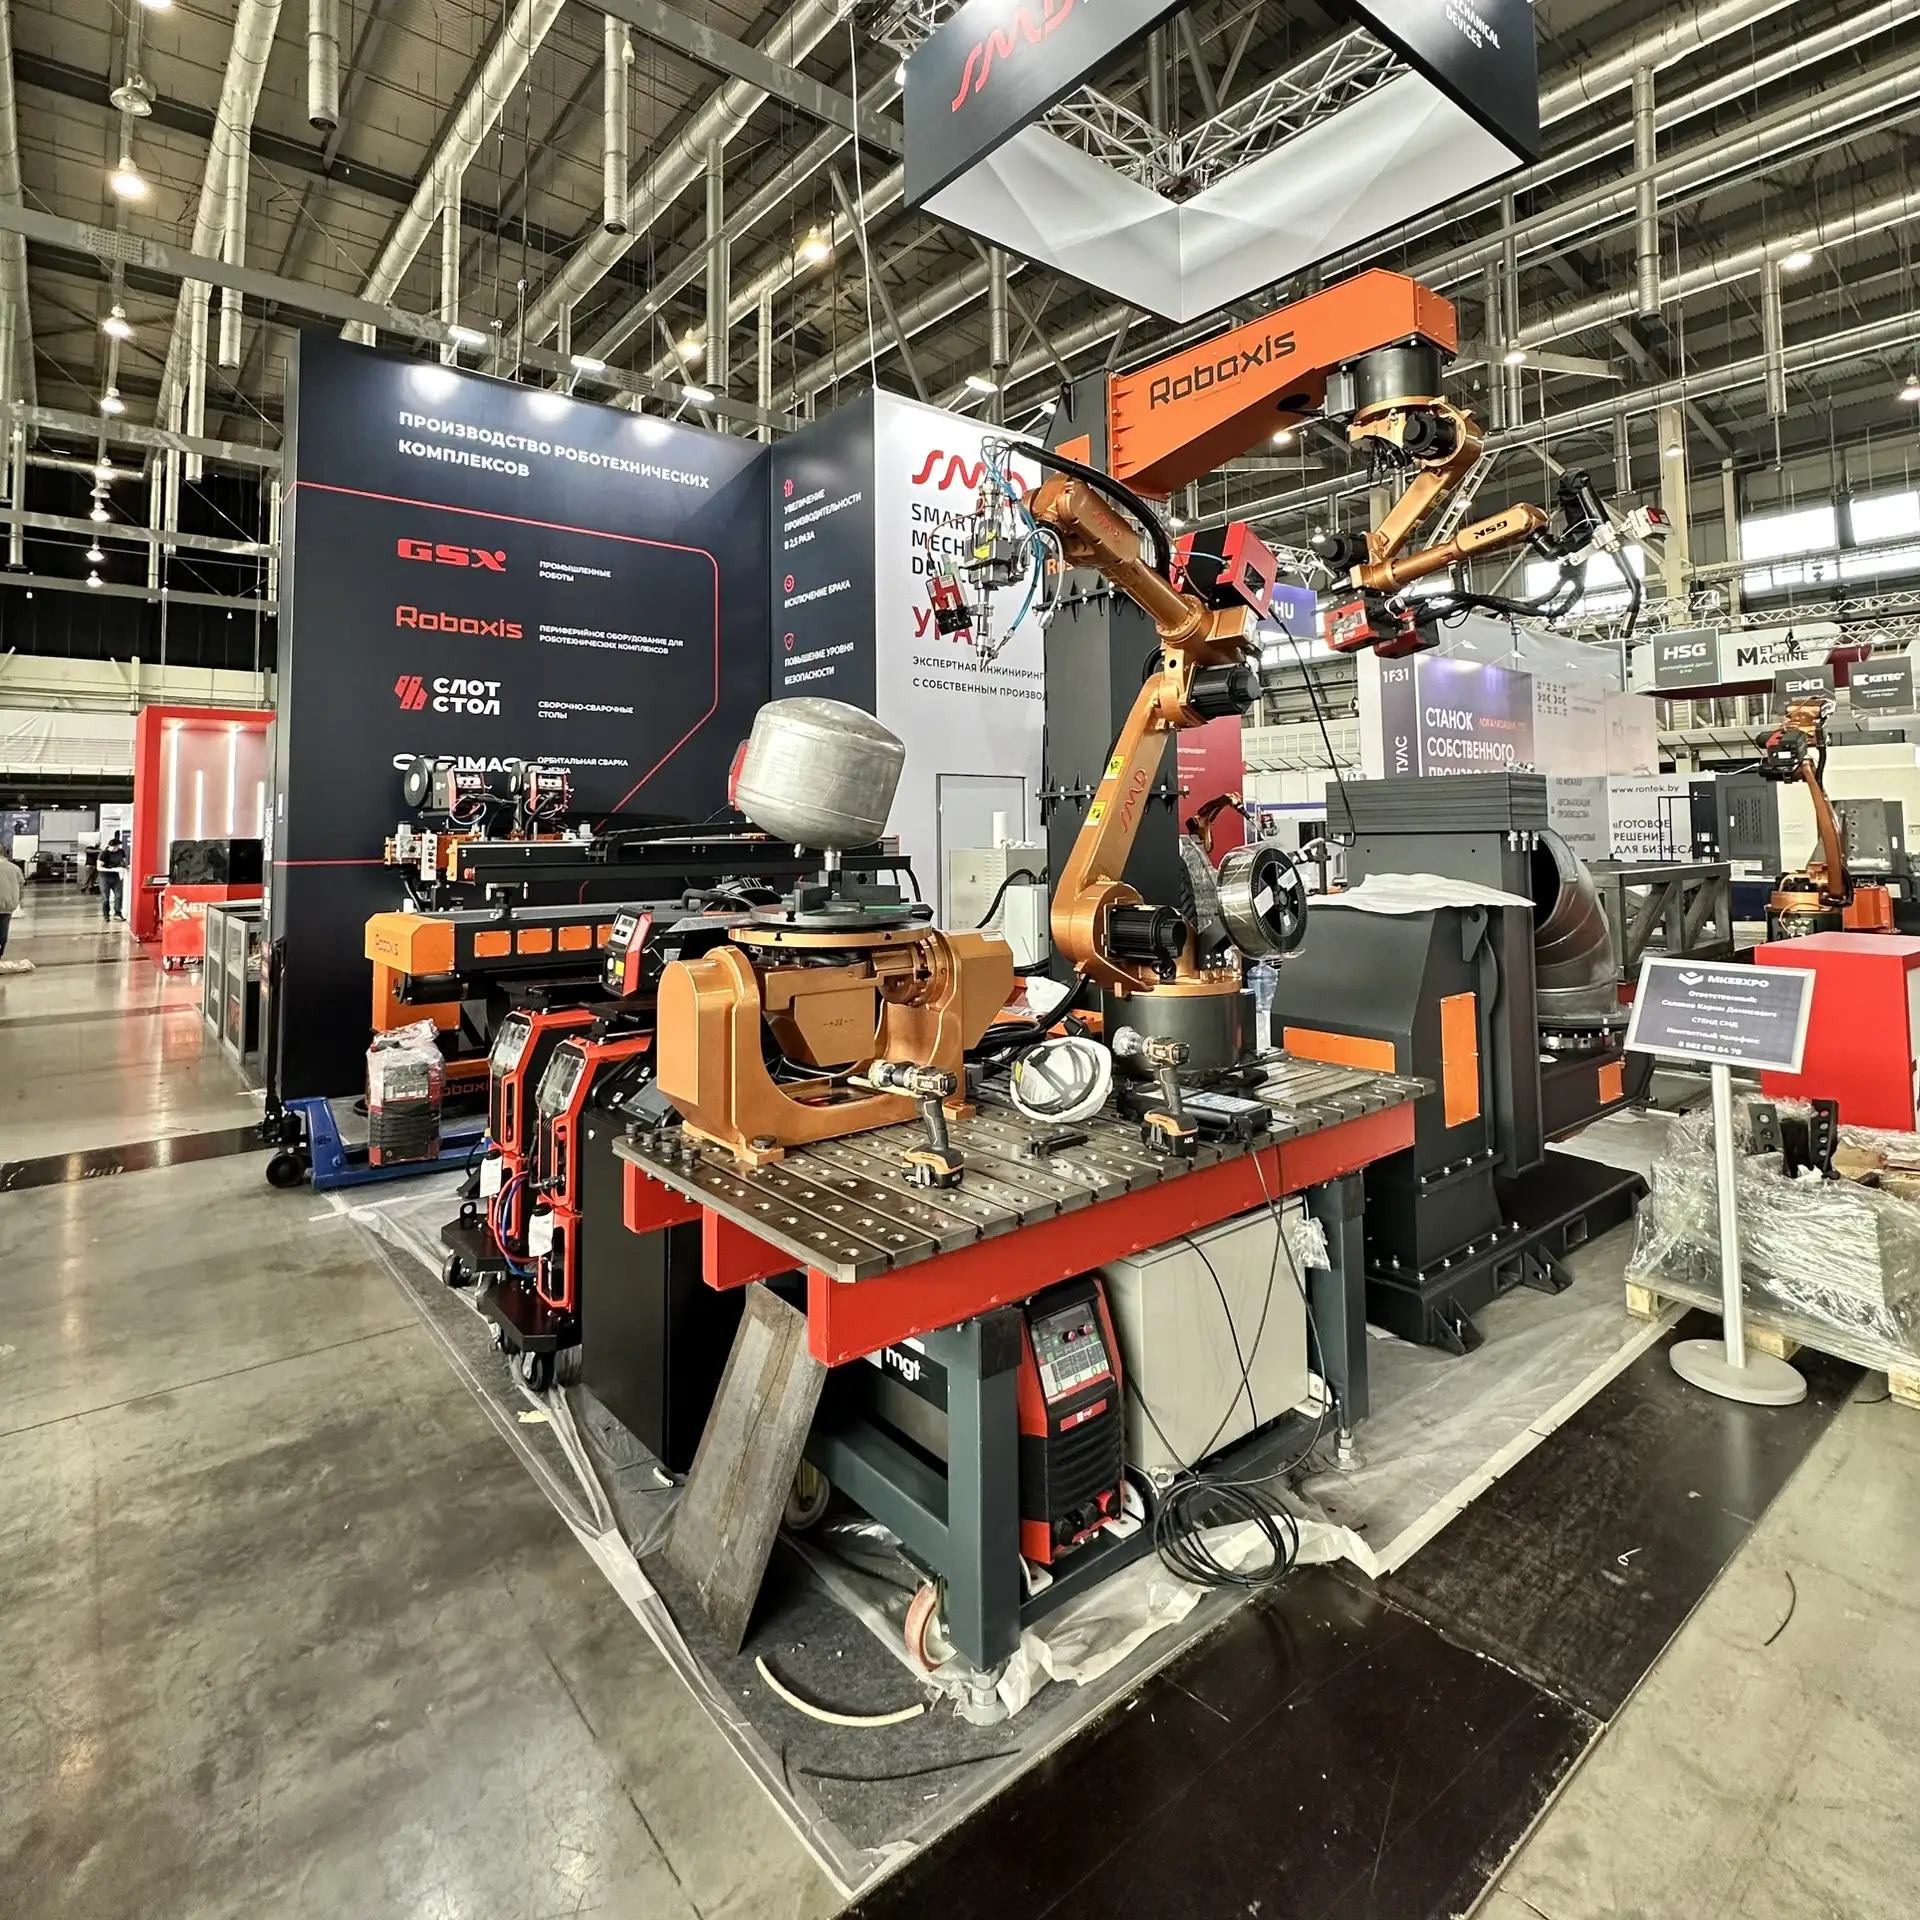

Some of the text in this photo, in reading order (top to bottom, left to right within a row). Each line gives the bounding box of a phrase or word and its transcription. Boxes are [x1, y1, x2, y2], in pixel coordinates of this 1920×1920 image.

[1446, 4, 1483, 49] DEVICES
[1451, 0, 1501, 49] ECHANICAL
[1150, 331, 1297, 410] Roboxis
[398, 439, 530, 477] КОМПЛЕКСОВ
[399, 411, 710, 489] ПРОИЗВОДСТВО РОБОТЕХНИЧЕСКИХ
[784, 488, 826, 515] УВЕЛИЧЕНИЕ
[784, 492, 862, 532] ПРОИЗВОДИТЕЛЬНОСТИ
[798, 530, 815, 546] РАЗА
[397, 538, 507, 572] GSX
[539, 560, 612, 578] ПРОМЫШЛЕННЫЕ
[539, 570, 574, 582] РОБОТЫ
[784, 579, 851, 608] ИСКЛЮЧЕНИЕ БРАКА
[395, 605, 523, 639] Roboxis
[539, 625, 683, 648] ПЕРИФЕРИЙНОЕ ОБОРУДОВАНИЕ ДЛЯ
[539, 634, 669, 655] РОБОТЕХНИЧЕСКИХ КОМПЛЕКСОВ
[784, 642, 854, 667] ПОВЫШЕНИЕ УРОВНЯ
[1663, 643, 1707, 661] HSG
[784, 666, 835, 686] БЕЗОПАСНОСТИ
[913, 656, 1044, 680] ЭКСПЕРТНАЯ ИНЖИНИРИНГ
[1383, 668, 1409, 683] 1F31
[432, 677, 501, 697] СЛОТ
[913, 678, 1047, 701] С СОБСТВЕННЫМ ПРОИЗВО
[432, 696, 501, 715] СТОЛ
[538, 700, 634, 714] СБОРОЧНО-СВАРОЧНЫЕ
[538, 710, 568, 720] СТОЛЫ
[1425, 706, 1474, 731] СТАНОК
[1427, 736, 1515, 762] СОБСТВЕННОГО
[537, 756, 629, 767] ОРБИТАЛЬНАЯ СВАРКА
[1611, 784, 1680, 794] www.rontek.by
[1614, 832, 1665, 841] РЕШЕНИЕ
[1614, 844, 1639, 854] ДЛЯ
[442, 1080, 489, 1097] oboxi
[886, 1346, 921, 1382] mgt
